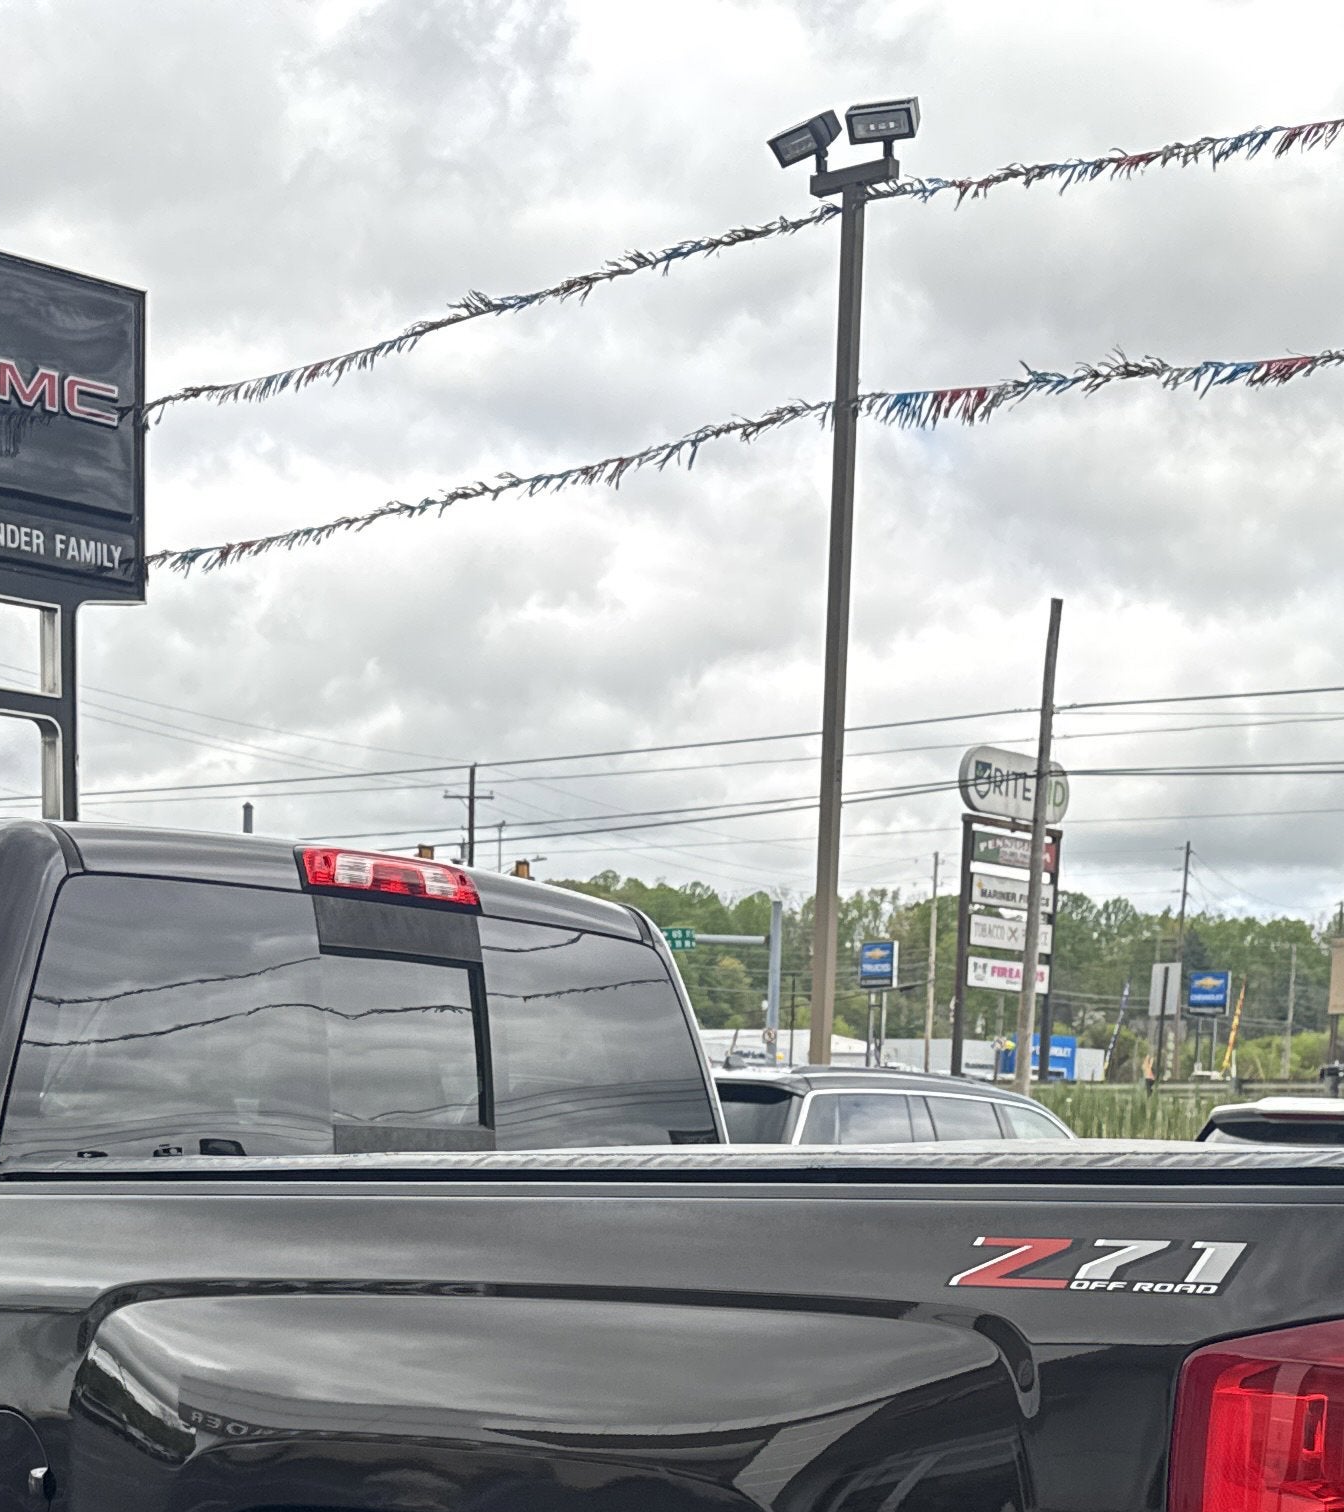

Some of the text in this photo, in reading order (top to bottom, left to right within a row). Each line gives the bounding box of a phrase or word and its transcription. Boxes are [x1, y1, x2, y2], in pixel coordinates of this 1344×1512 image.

[55, 532, 123, 570] FAMILY
[993, 767, 1033, 802] RITE
[991, 965, 1045, 983] FIREAS
[948, 1236, 1248, 1290] Z71
[1069, 1280, 1219, 1295] OFF ROAD
